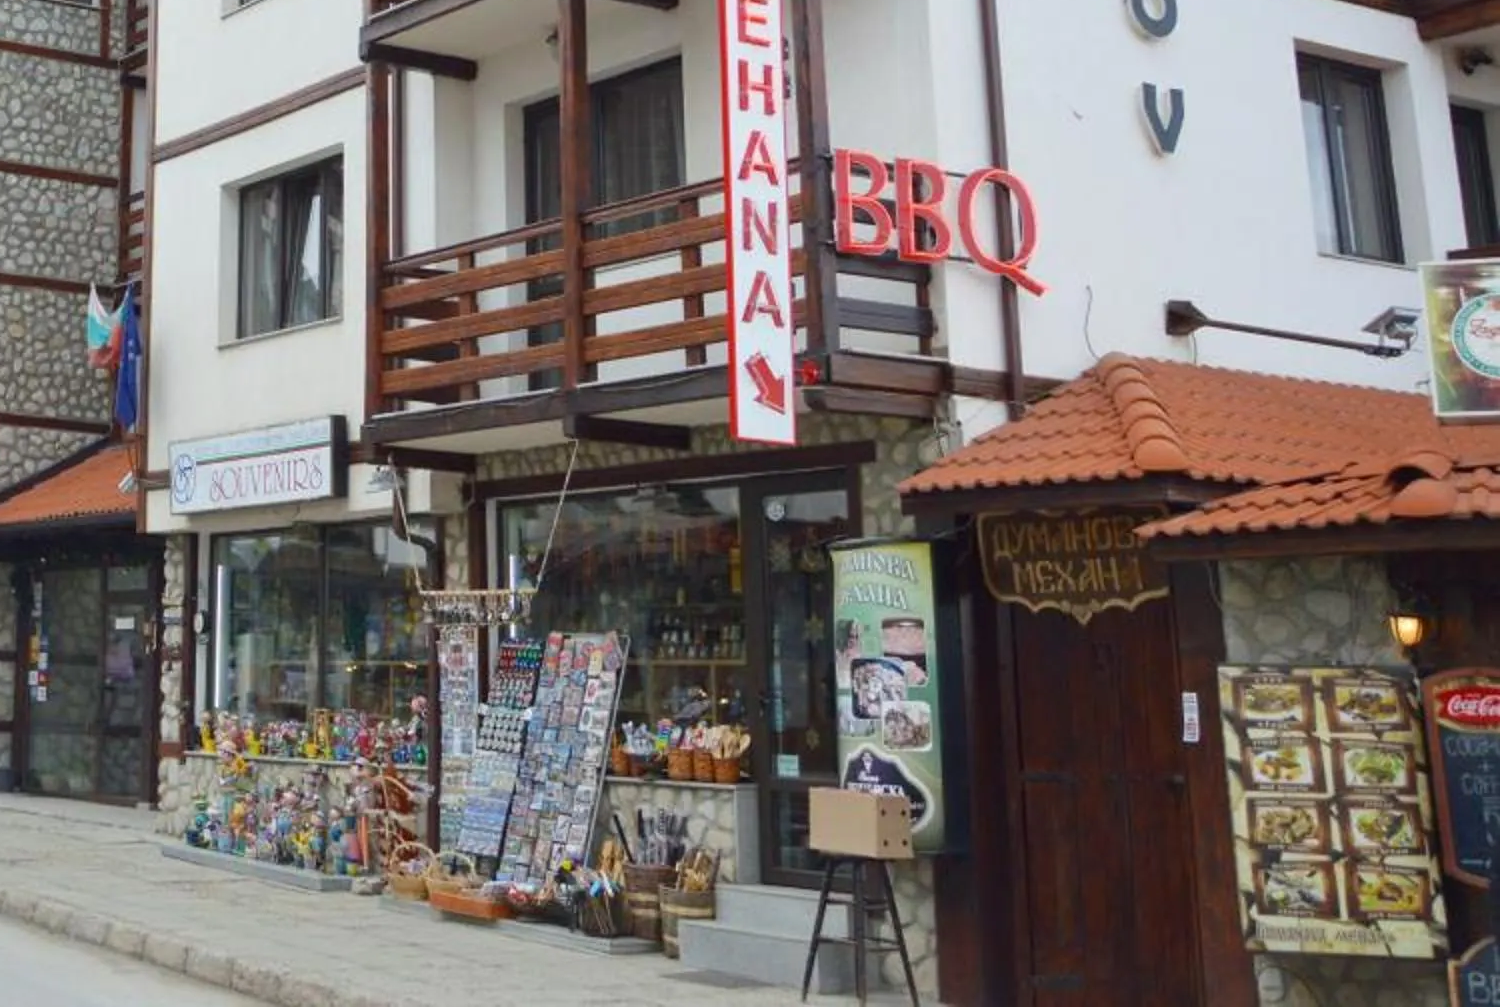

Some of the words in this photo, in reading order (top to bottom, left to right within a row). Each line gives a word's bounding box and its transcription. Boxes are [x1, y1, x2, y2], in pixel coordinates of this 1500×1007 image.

[834, 148, 1048, 296] BBQ
[209, 453, 324, 502] SOUVENIRS
[994, 515, 1145, 561] ДУМАНОВ
